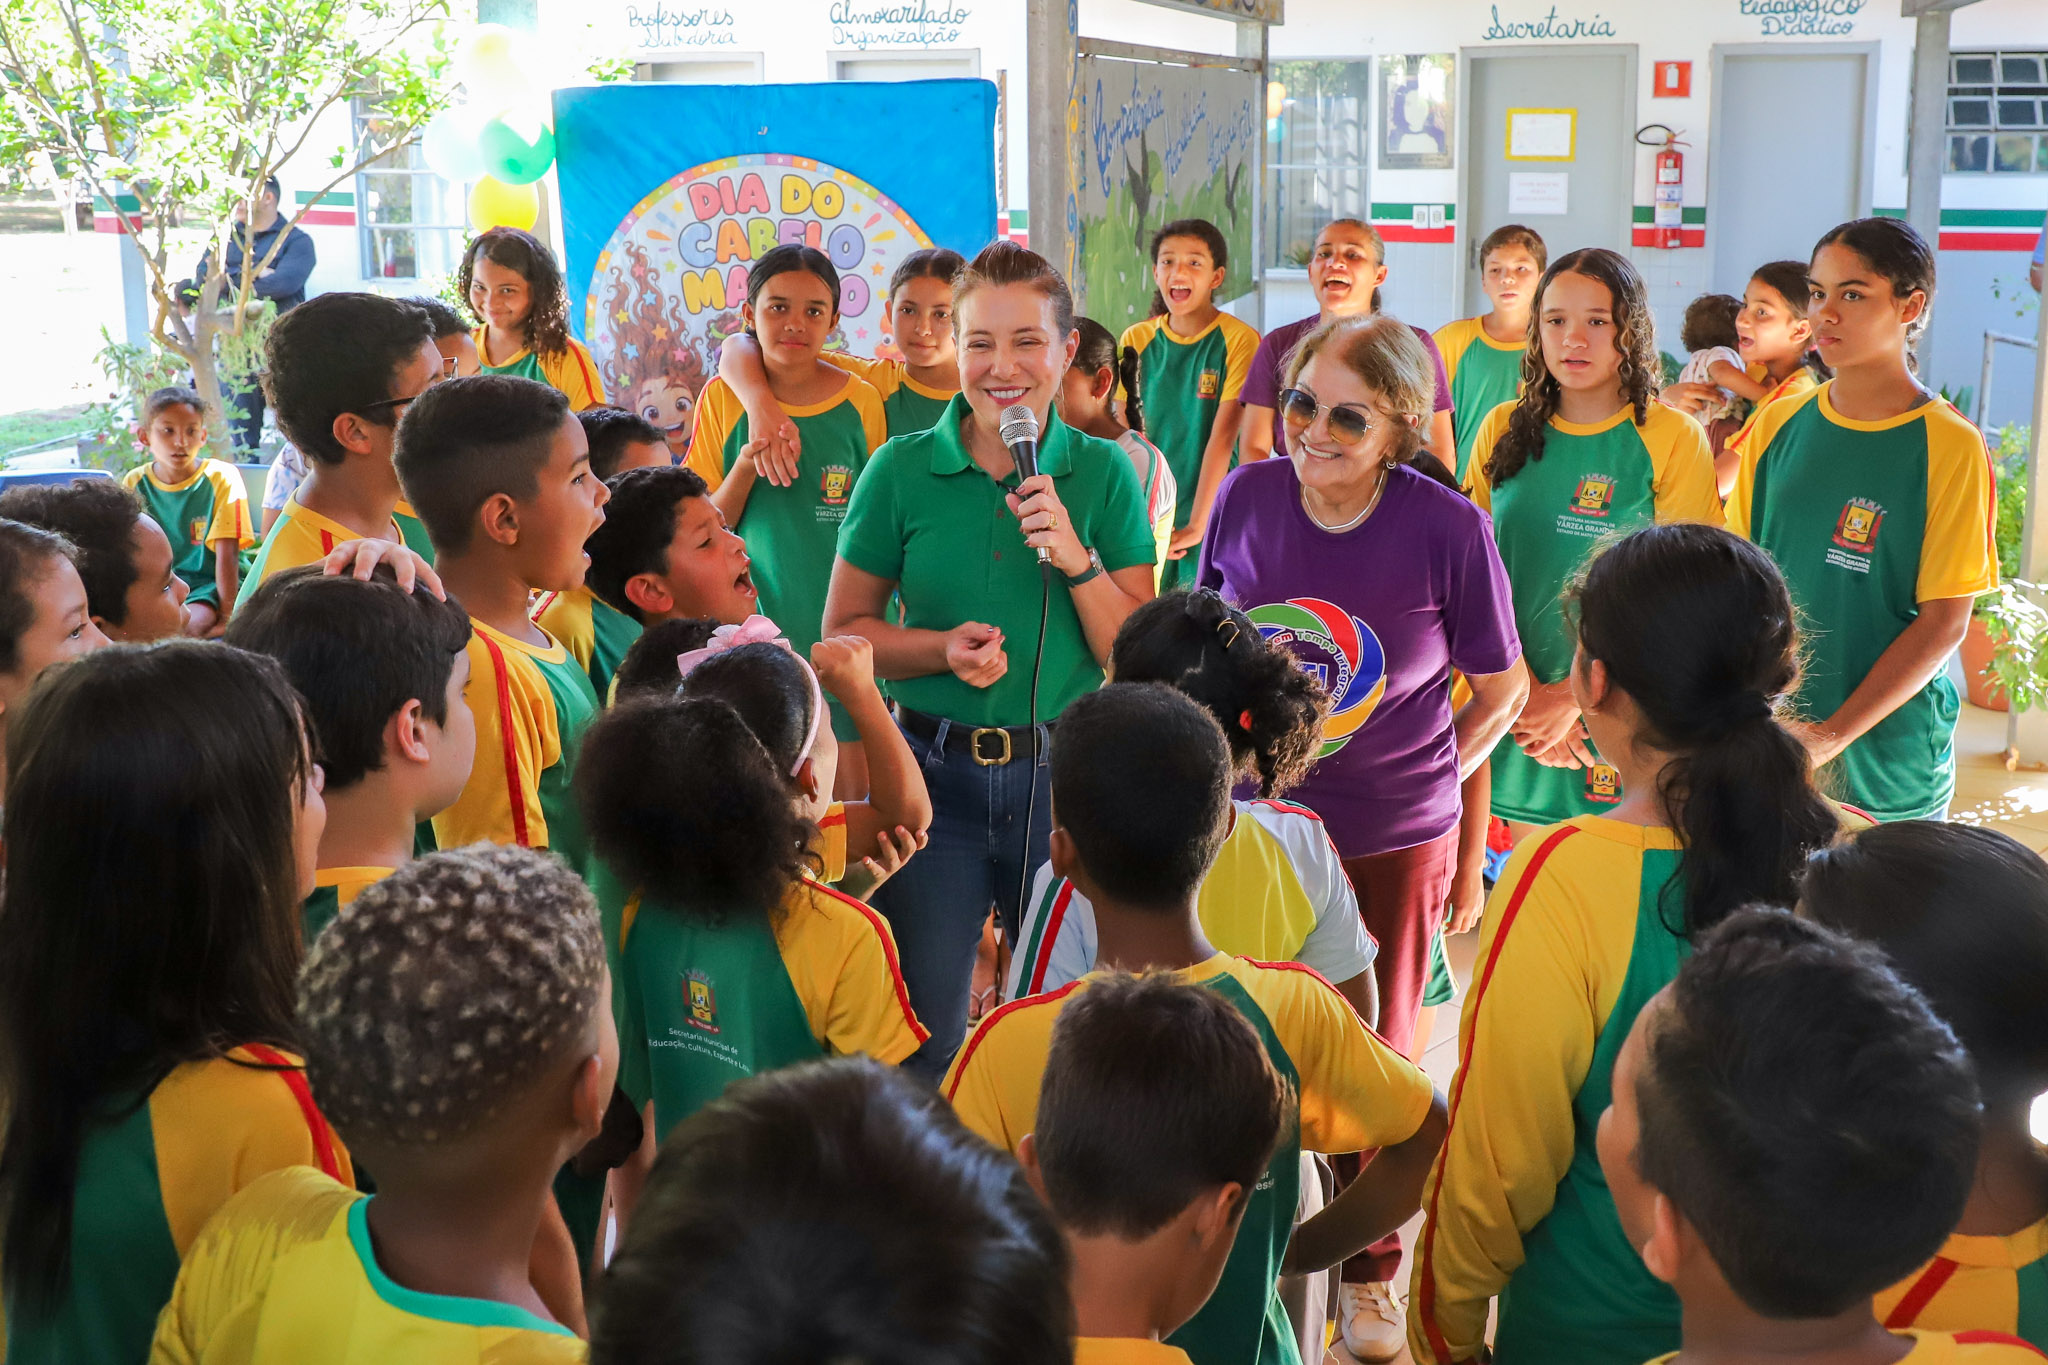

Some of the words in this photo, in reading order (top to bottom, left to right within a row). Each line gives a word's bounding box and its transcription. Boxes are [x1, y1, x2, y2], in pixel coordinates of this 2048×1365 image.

[829, 0, 972, 36] Almoxarifado
[1482, 4, 1616, 40] Secretaria
[833, 25, 962, 51] Organização
[688, 173, 770, 221] DIA
[780, 174, 845, 219] DO
[1556, 519, 1585, 532] VÁRZEA
[1272, 632, 1293, 645] em
[1296, 630, 1338, 653] Tempo
[1331, 652, 1349, 700] Integral
[668, 1027, 703, 1041] Secretaria
[730, 1046, 738, 1055] de
